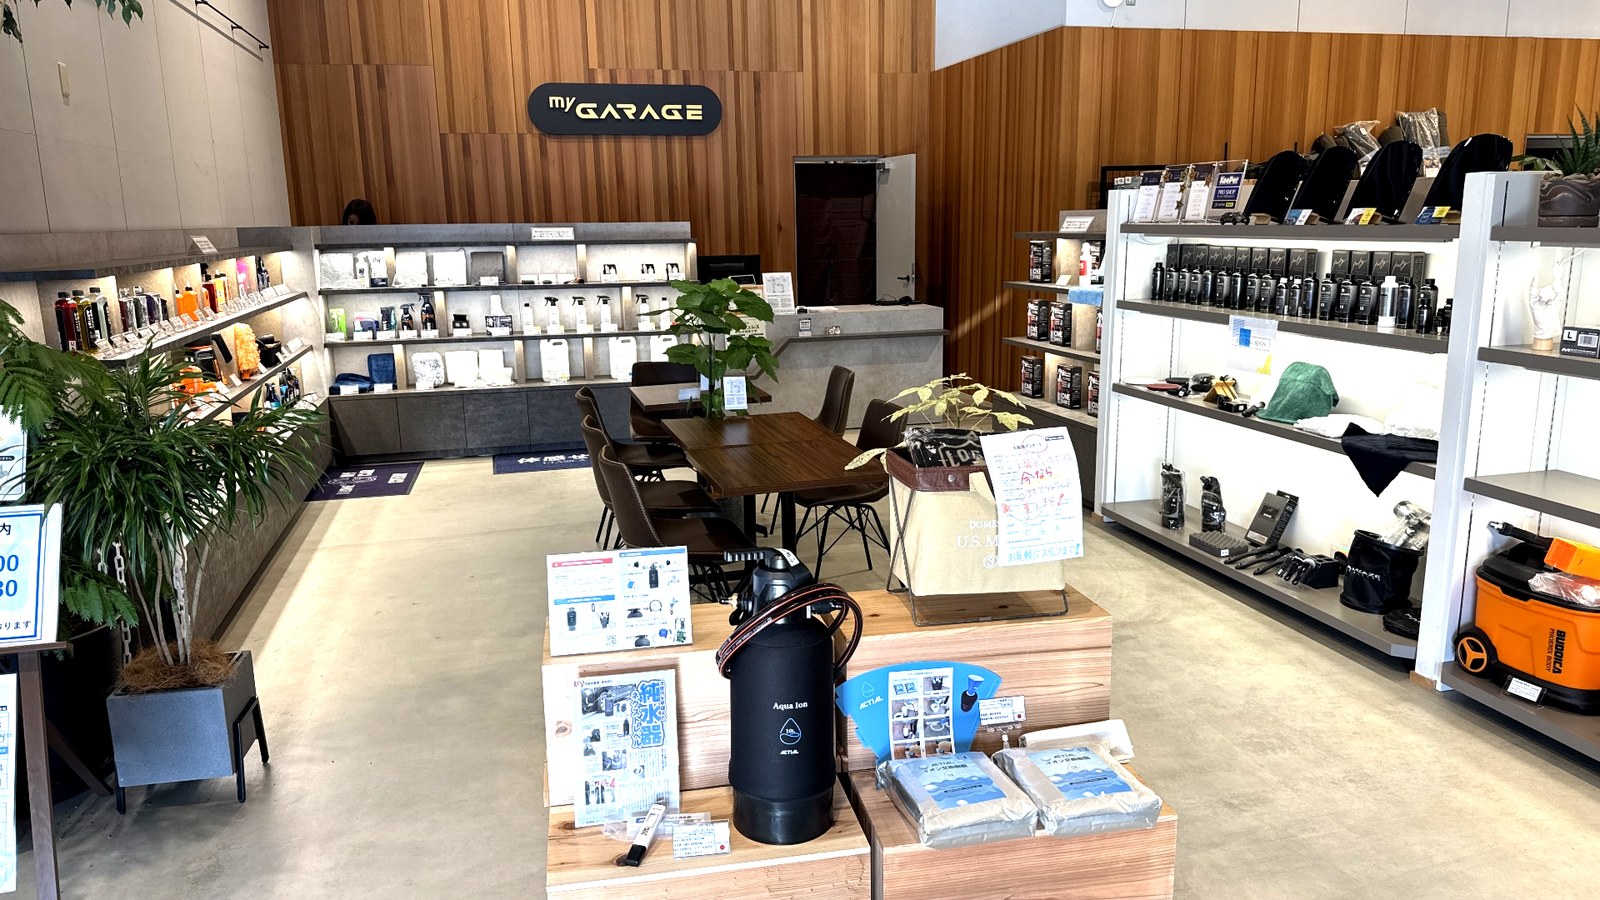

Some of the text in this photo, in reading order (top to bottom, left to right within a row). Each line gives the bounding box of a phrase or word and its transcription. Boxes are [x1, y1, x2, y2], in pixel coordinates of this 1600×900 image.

[549, 97, 703, 120] my GARAGE
[1567, 331, 1572, 339] L
[970, 520, 998, 529] DOME
[0, 620, 31, 631] ります
[1552, 629, 1566, 674] BUDDICA
[639, 682, 664, 746] 純水器
[773, 702, 793, 711] Aqua
[631, 691, 642, 747] ネクストレベル
